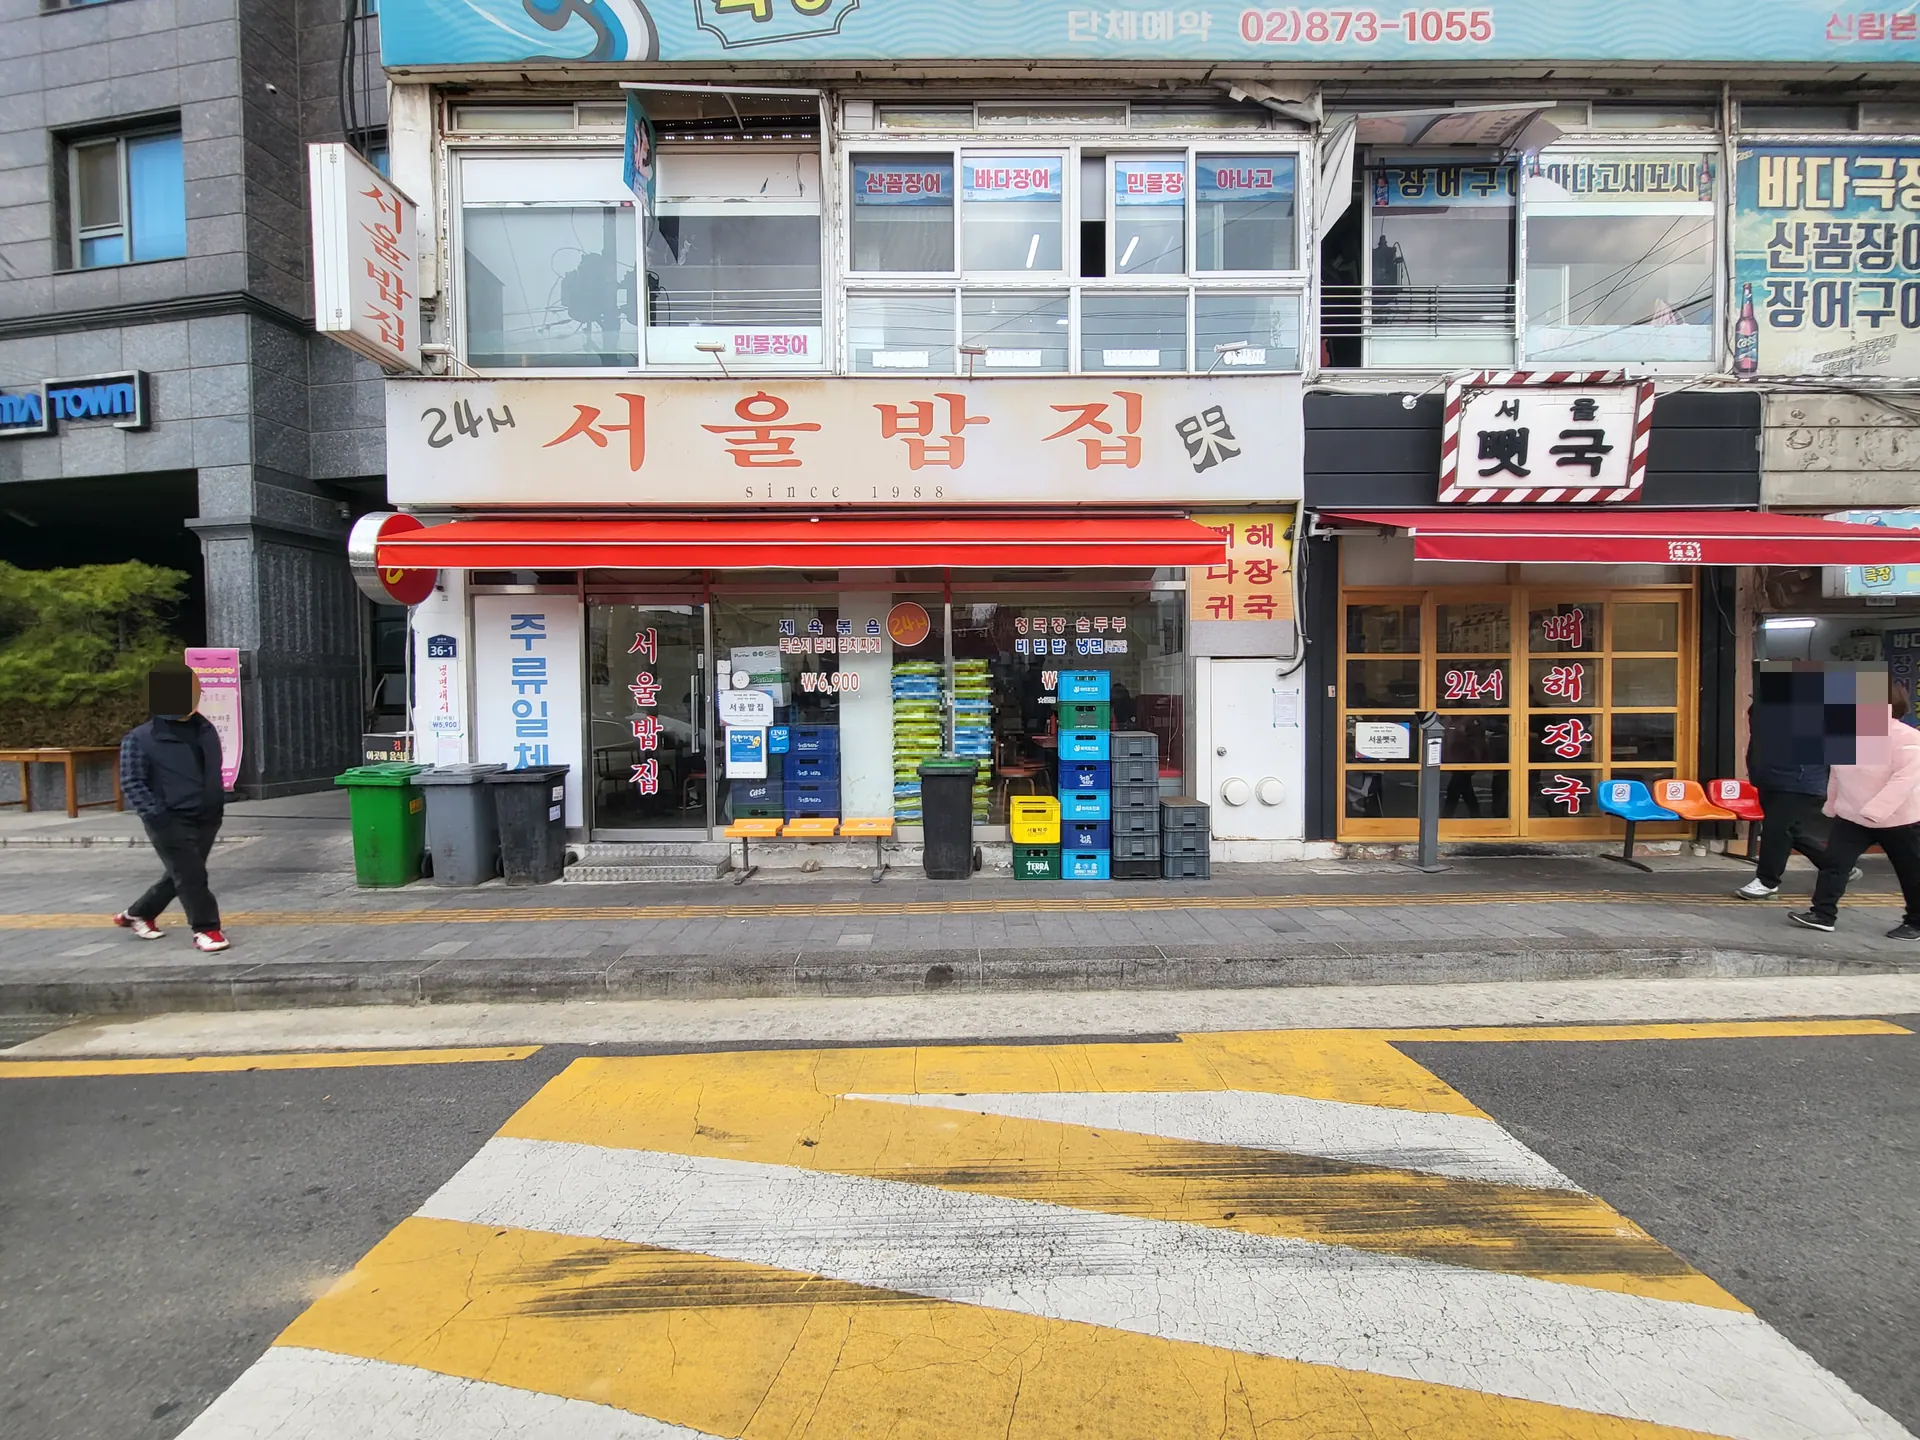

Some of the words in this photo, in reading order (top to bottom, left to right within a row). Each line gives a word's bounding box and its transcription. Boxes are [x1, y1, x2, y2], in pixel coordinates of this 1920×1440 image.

[1067, 10, 1212, 42] 단체예약
[1240, 10, 1493, 43] 02)873-1055
[866, 172, 941, 194] 산꼼장어
[974, 168, 1049, 189] 바다장어
[1217, 168, 1273, 189] 아나고
[358, 182, 412, 352] 서울밥집
[734, 334, 809, 356] 민물장어
[1494, 397, 1600, 422] 서울
[541, 390, 1143, 471] 서울밥집
[745, 482, 840, 499] since
[871, 485, 944, 499] 1988
[1243, 523, 1279, 620] 해장국
[779, 618, 881, 635] 제육볶음
[1015, 617, 1067, 634] 청국장
[1076, 617, 1127, 633] 순두부
[430, 645, 454, 657] 36-1
[779, 638, 812, 654] 묵은지
[838, 638, 882, 654] 김치찌개
[1015, 639, 1067, 655] 비빔밥
[1076, 639, 1103, 655] 냉면
[509, 613, 549, 772] 주류일체
[801, 672, 861, 695] ₩6,900
[1444, 668, 1503, 701] 24시
[627, 627, 664, 795] 서울밥집
[729, 702, 764, 712] 서울밥집
[1541, 608, 1593, 815] 뼈해장국
[366, 750, 388, 761] 이곳에
[749, 787, 767, 797] Cass
[1025, 860, 1050, 871] TERRA
